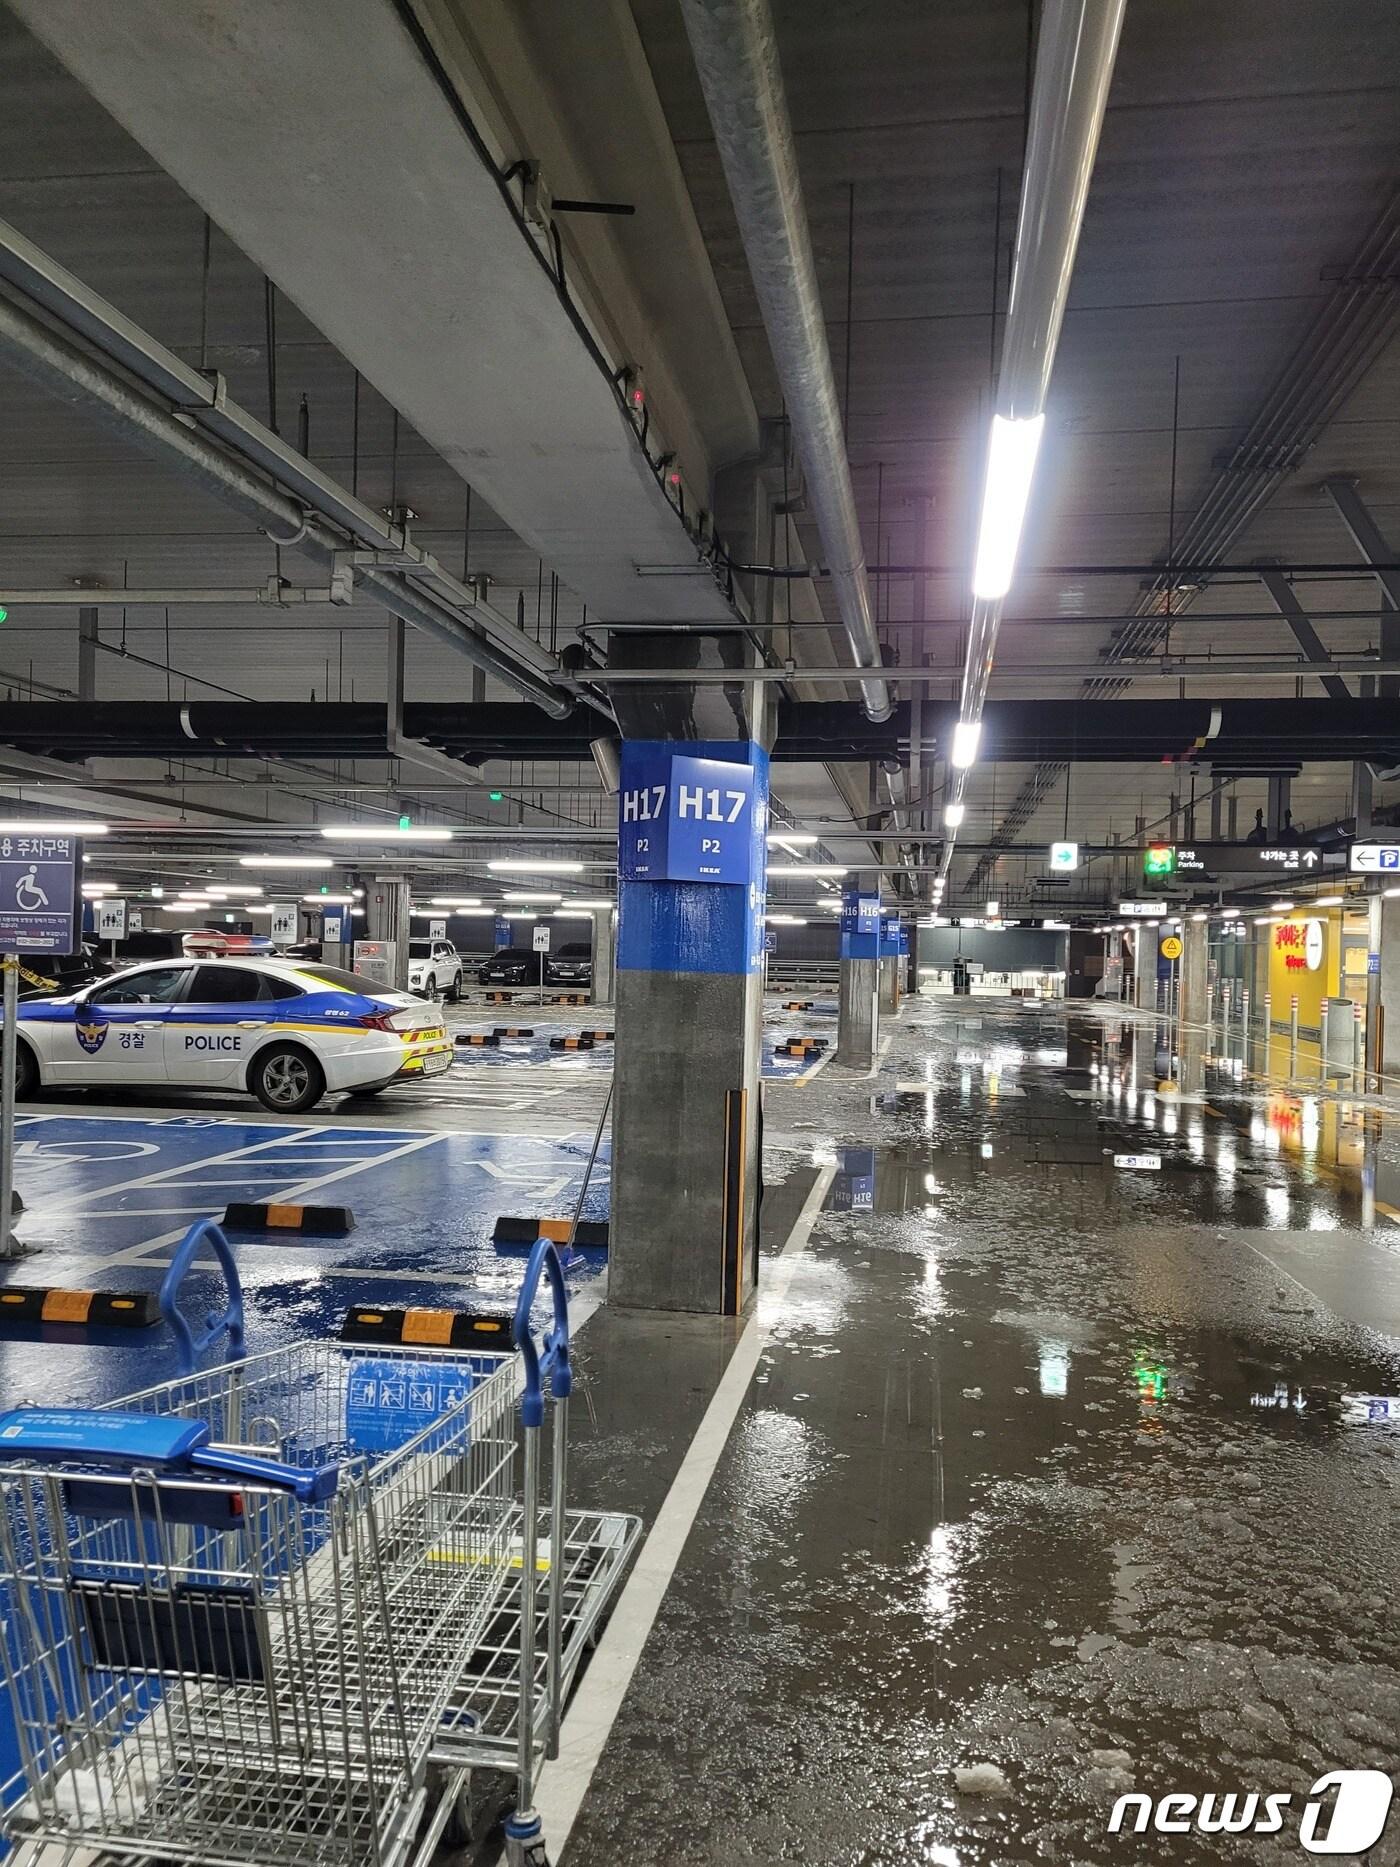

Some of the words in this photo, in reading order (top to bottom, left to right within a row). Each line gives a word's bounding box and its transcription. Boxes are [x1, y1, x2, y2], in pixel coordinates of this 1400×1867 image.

[623, 785, 666, 822] H17
[679, 785, 746, 823] H17
[17, 838, 70, 857] 주차구역
[637, 838, 649, 852] P2
[702, 839, 720, 853] P2
[1178, 851, 1196, 860] 주차
[1178, 861, 1204, 869] Parking
[842, 906, 857, 917] H16
[860, 906, 878, 917] H16
[118, 1032, 146, 1049] 경찰
[423, 1031, 437, 1040] POLICE
[185, 1036, 241, 1050] POLICE
